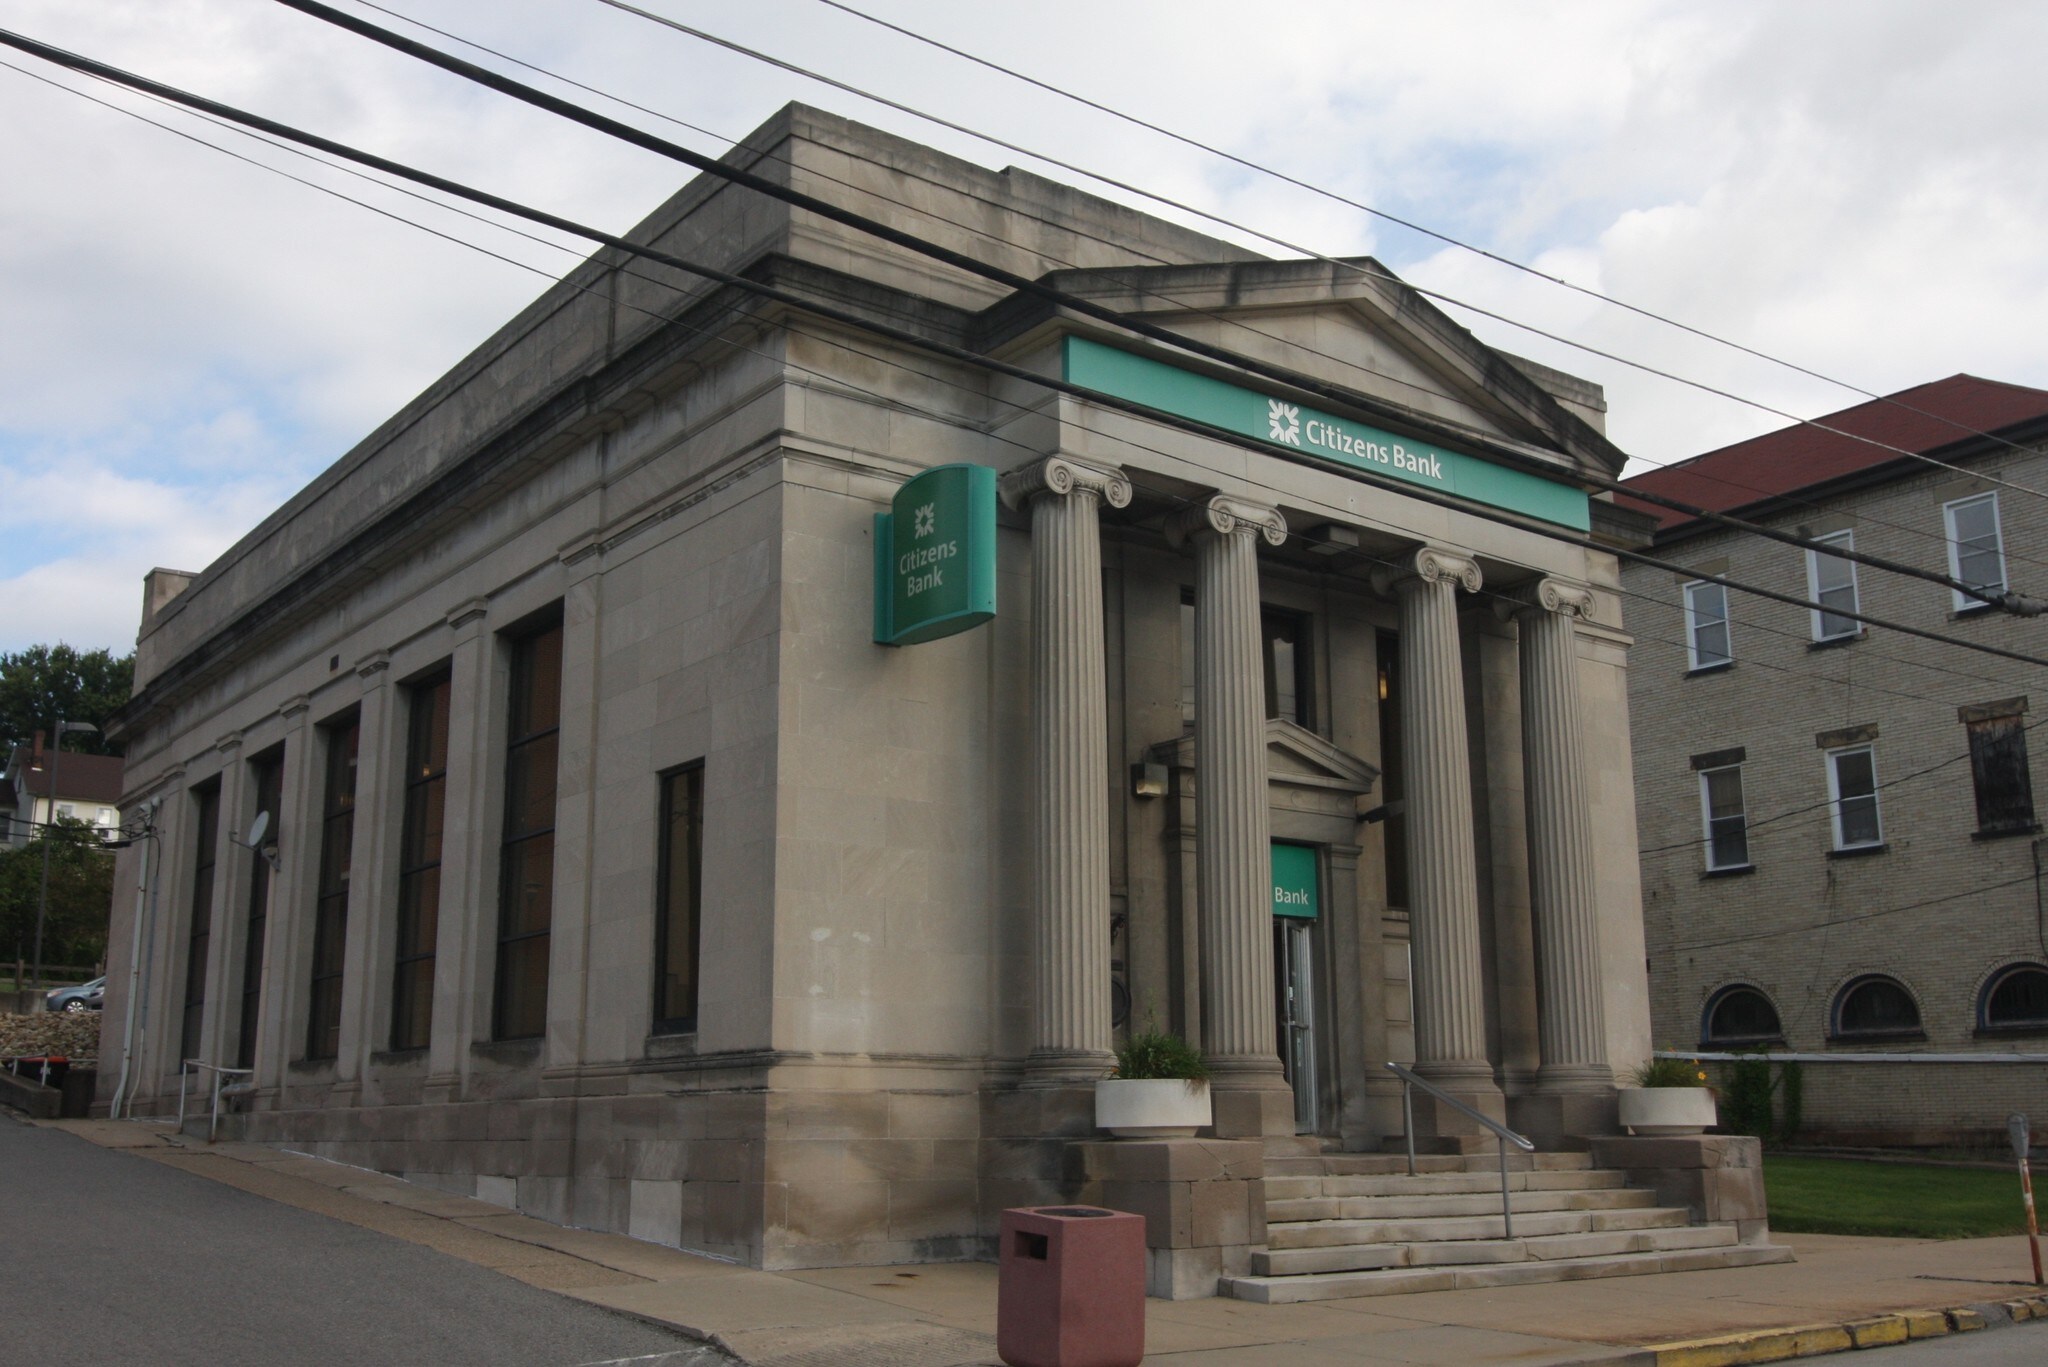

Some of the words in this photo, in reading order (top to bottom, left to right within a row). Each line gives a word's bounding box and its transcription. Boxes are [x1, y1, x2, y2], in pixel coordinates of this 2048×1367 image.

[1306, 420, 1389, 464] Citizens
[1392, 444, 1443, 480] Bank
[899, 540, 957, 575] Citizens
[907, 566, 943, 597] Bank
[1274, 887, 1309, 905] Bank
